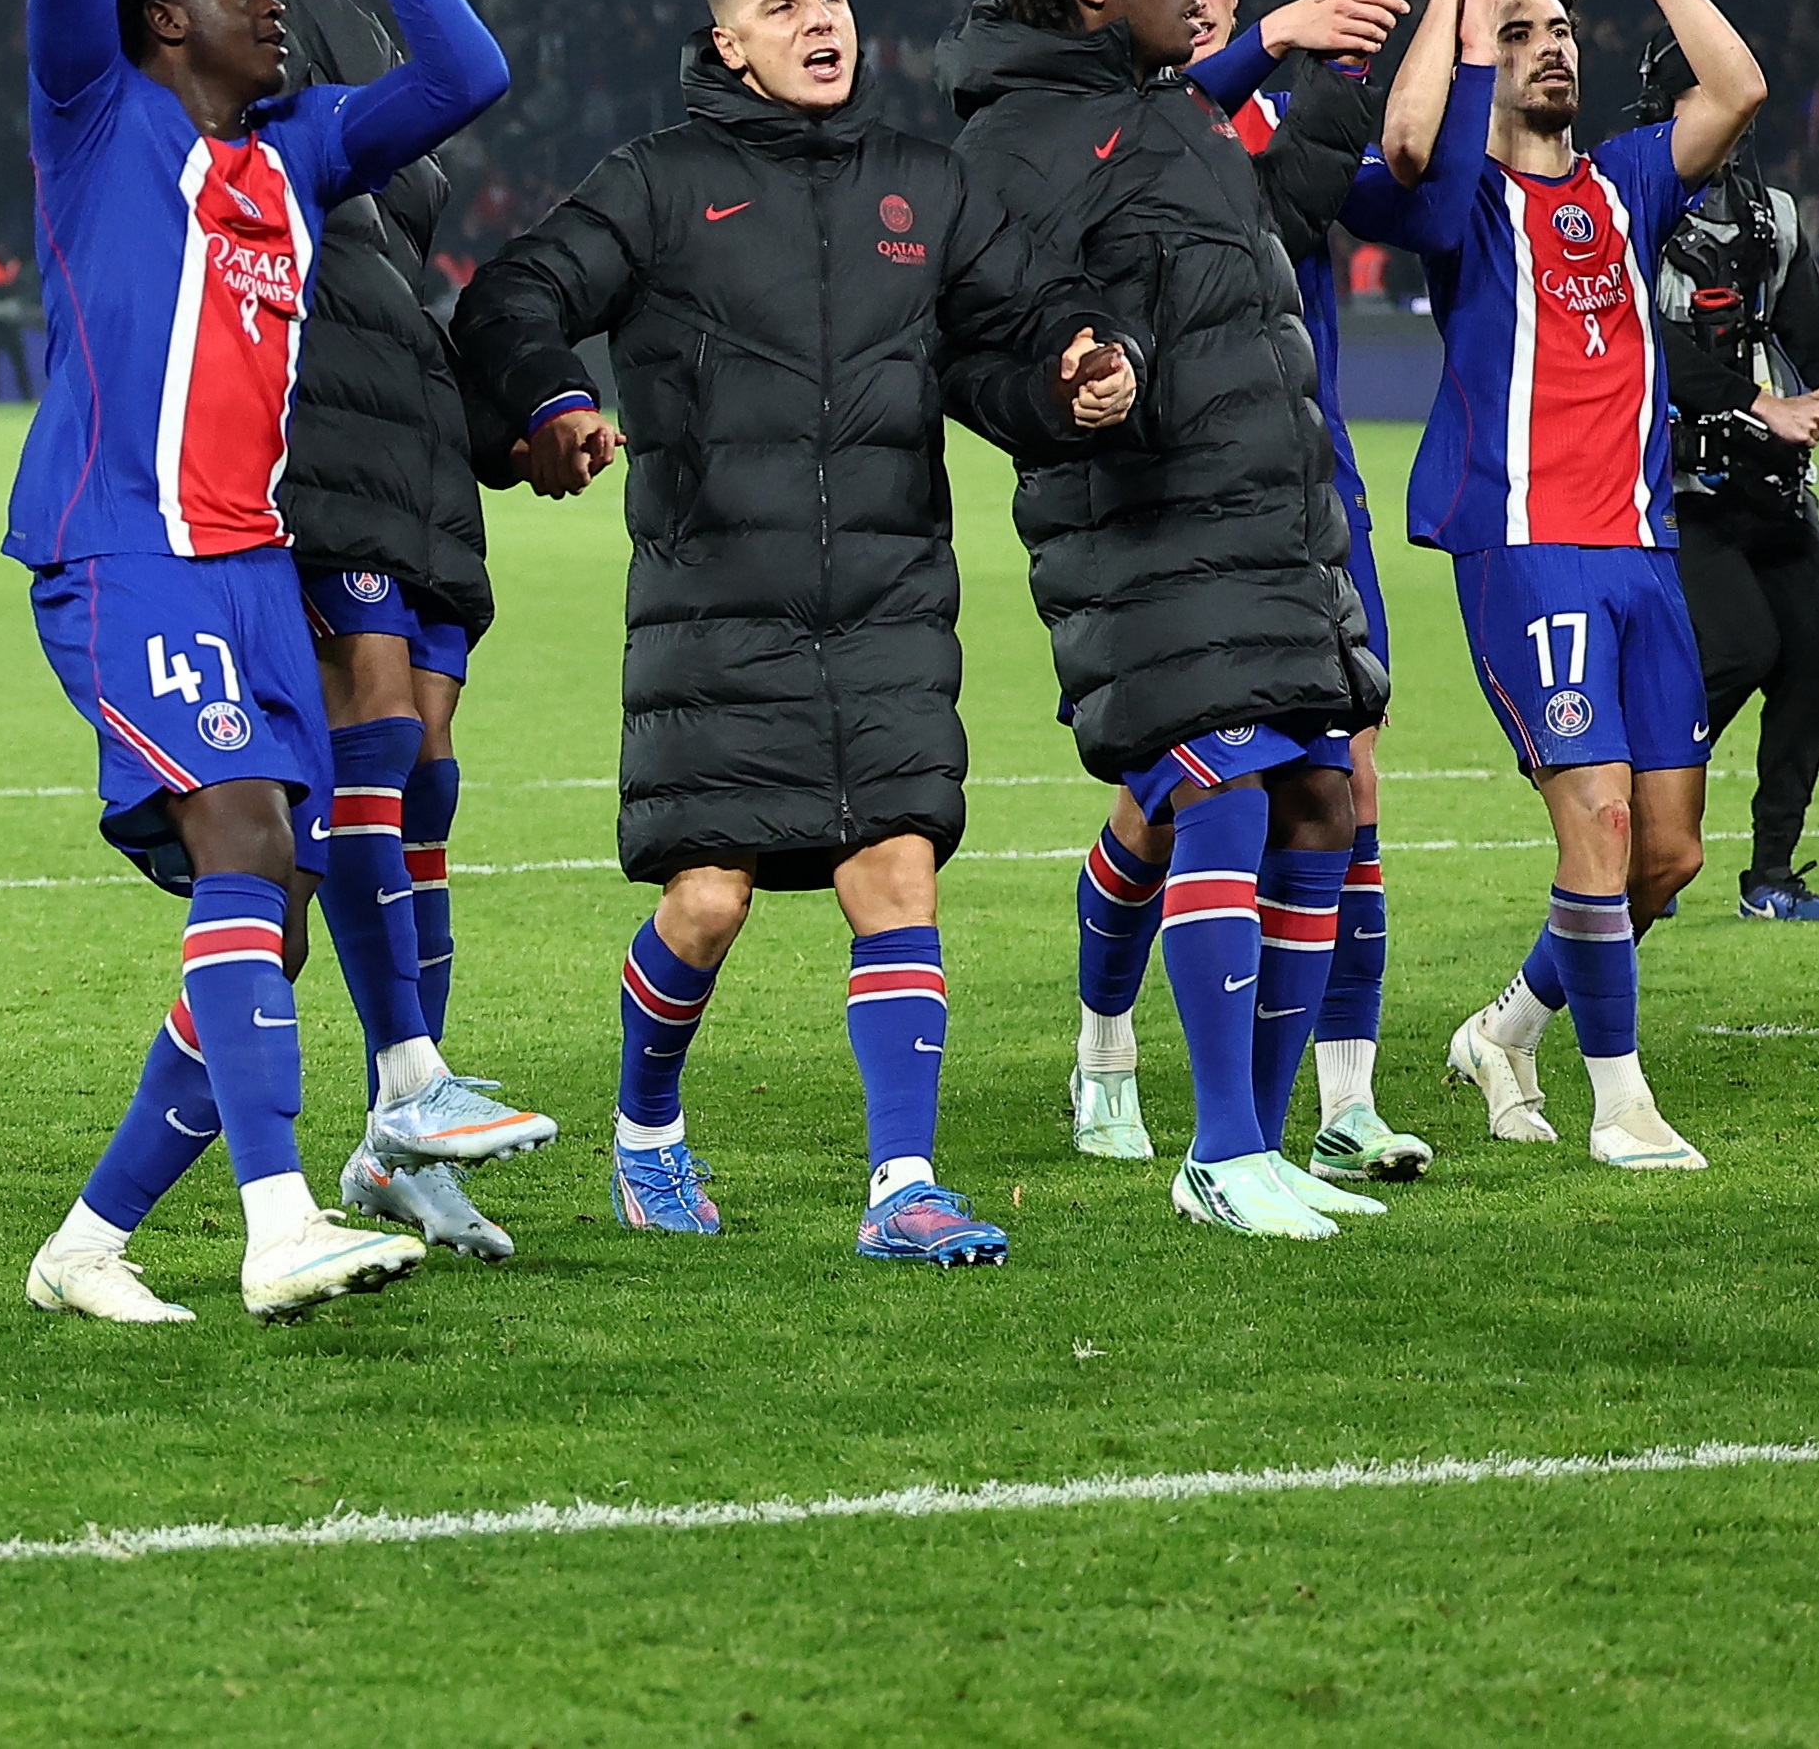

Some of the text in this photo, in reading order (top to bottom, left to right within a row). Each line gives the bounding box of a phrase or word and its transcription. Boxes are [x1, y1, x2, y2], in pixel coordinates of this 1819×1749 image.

[205, 231, 292, 284] QATAR
[877, 239, 926, 258] QATAR
[223, 271, 297, 302] AIRWAYS
[1541, 263, 1622, 300] QATAR
[145, 631, 242, 705] 47
[1527, 612, 1588, 688] 17
